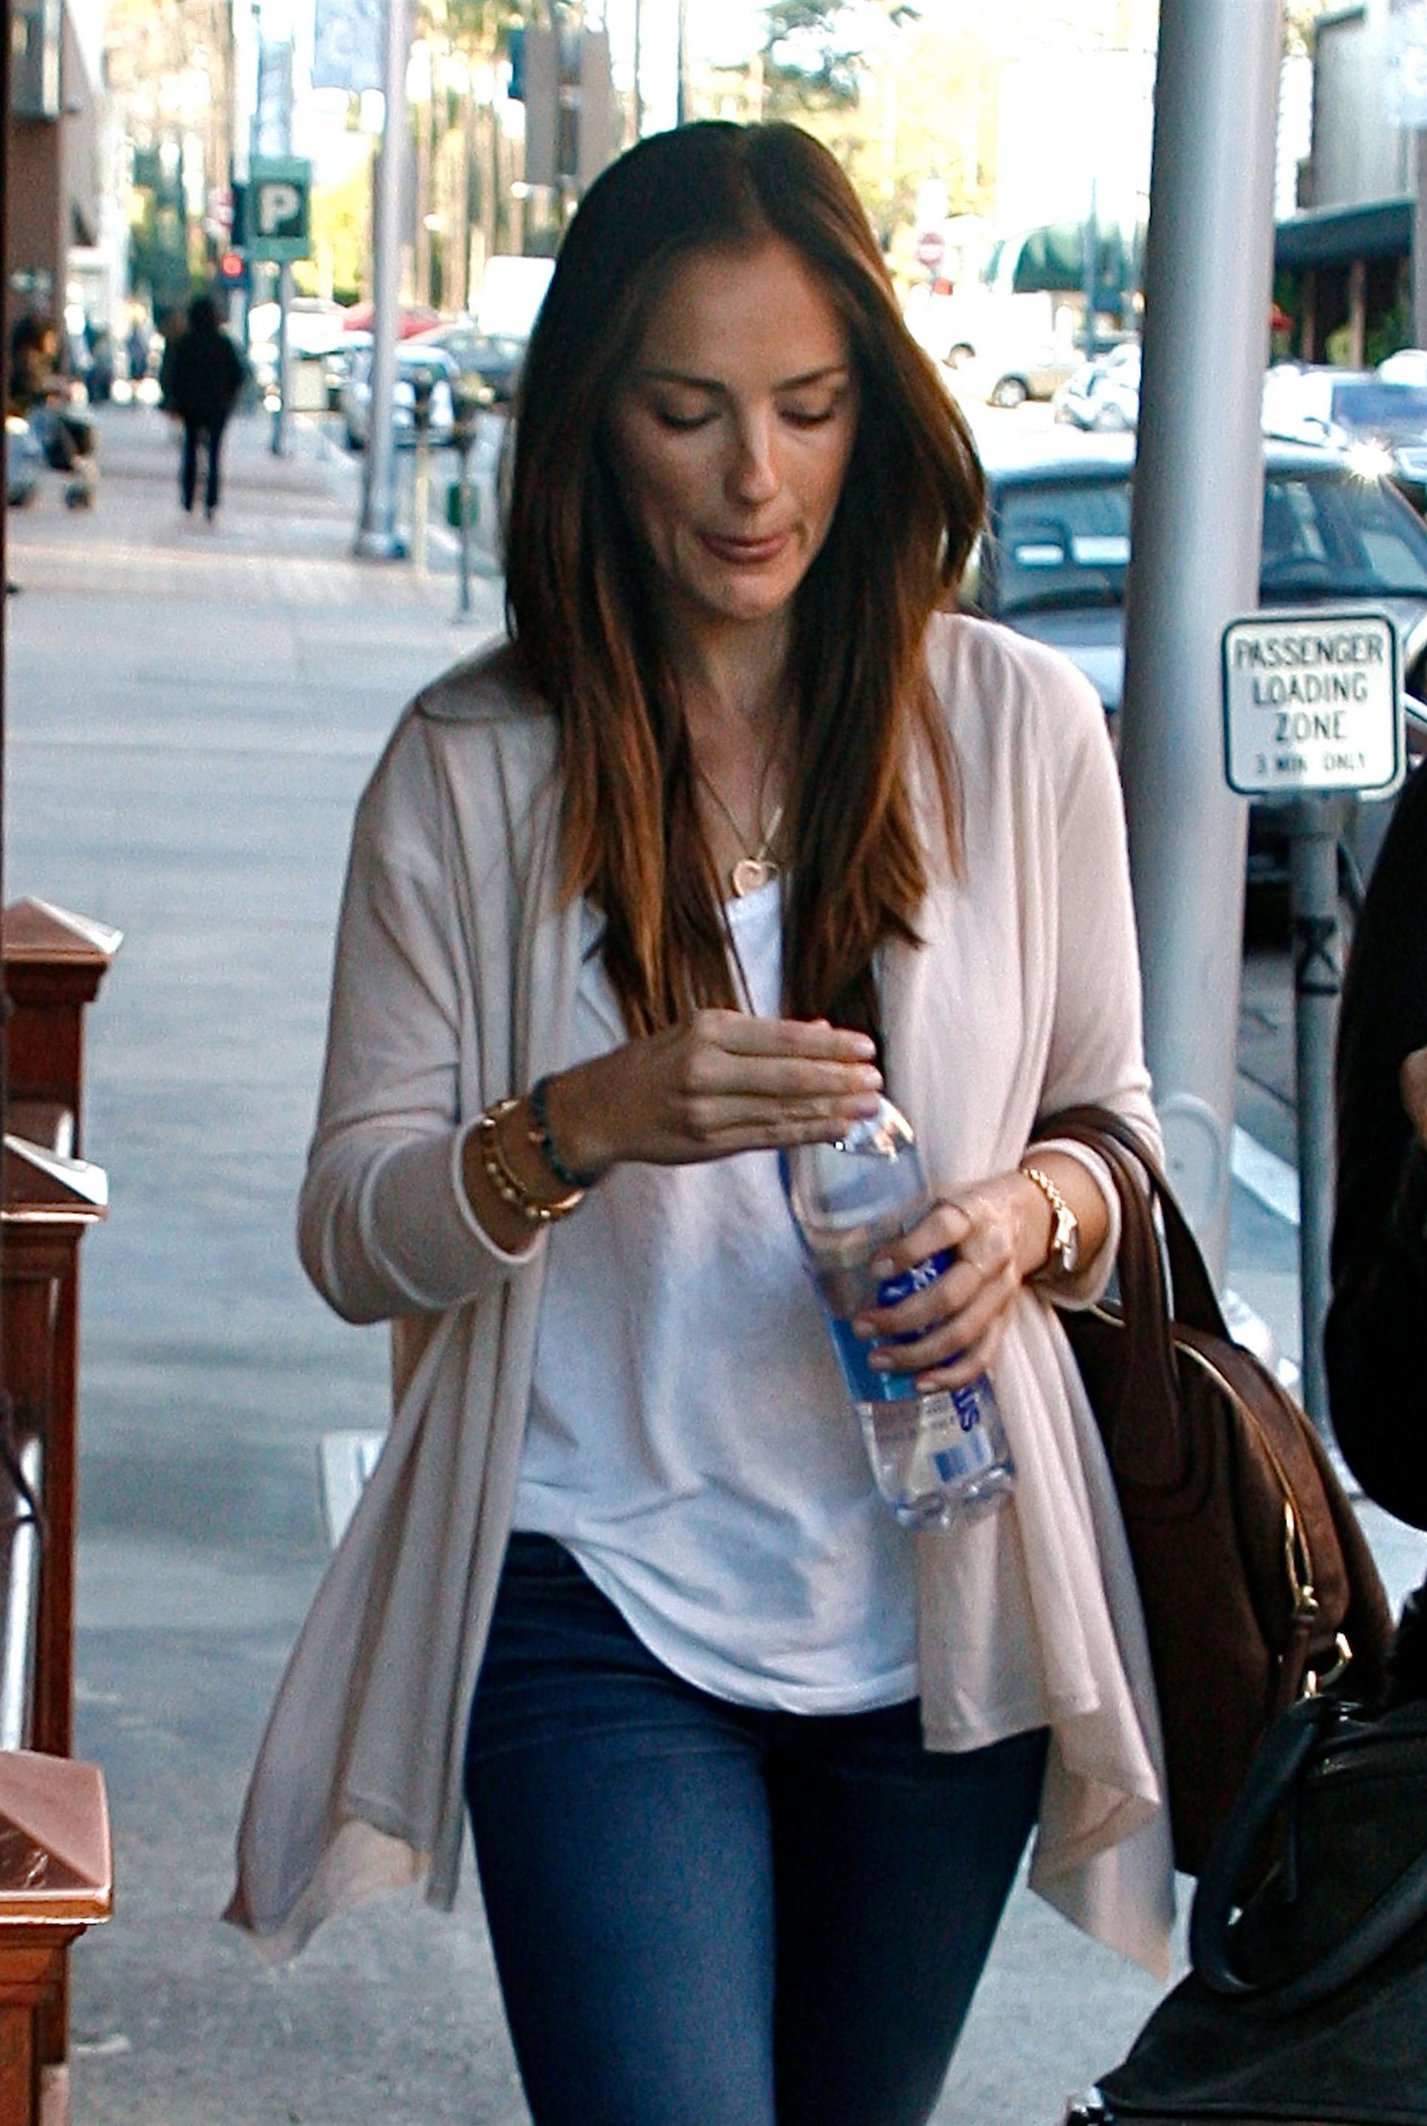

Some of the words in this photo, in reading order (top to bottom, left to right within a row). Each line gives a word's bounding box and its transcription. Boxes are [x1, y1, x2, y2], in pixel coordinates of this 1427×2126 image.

[260, 184, 299, 234] P
[1234, 633, 1384, 668] PASSENGER
[1253, 671, 1368, 705] LOADING
[1275, 710, 1346, 742] ZONE
[1276, 754, 1307, 772] MIN
[1323, 751, 1365, 772] ONLY
